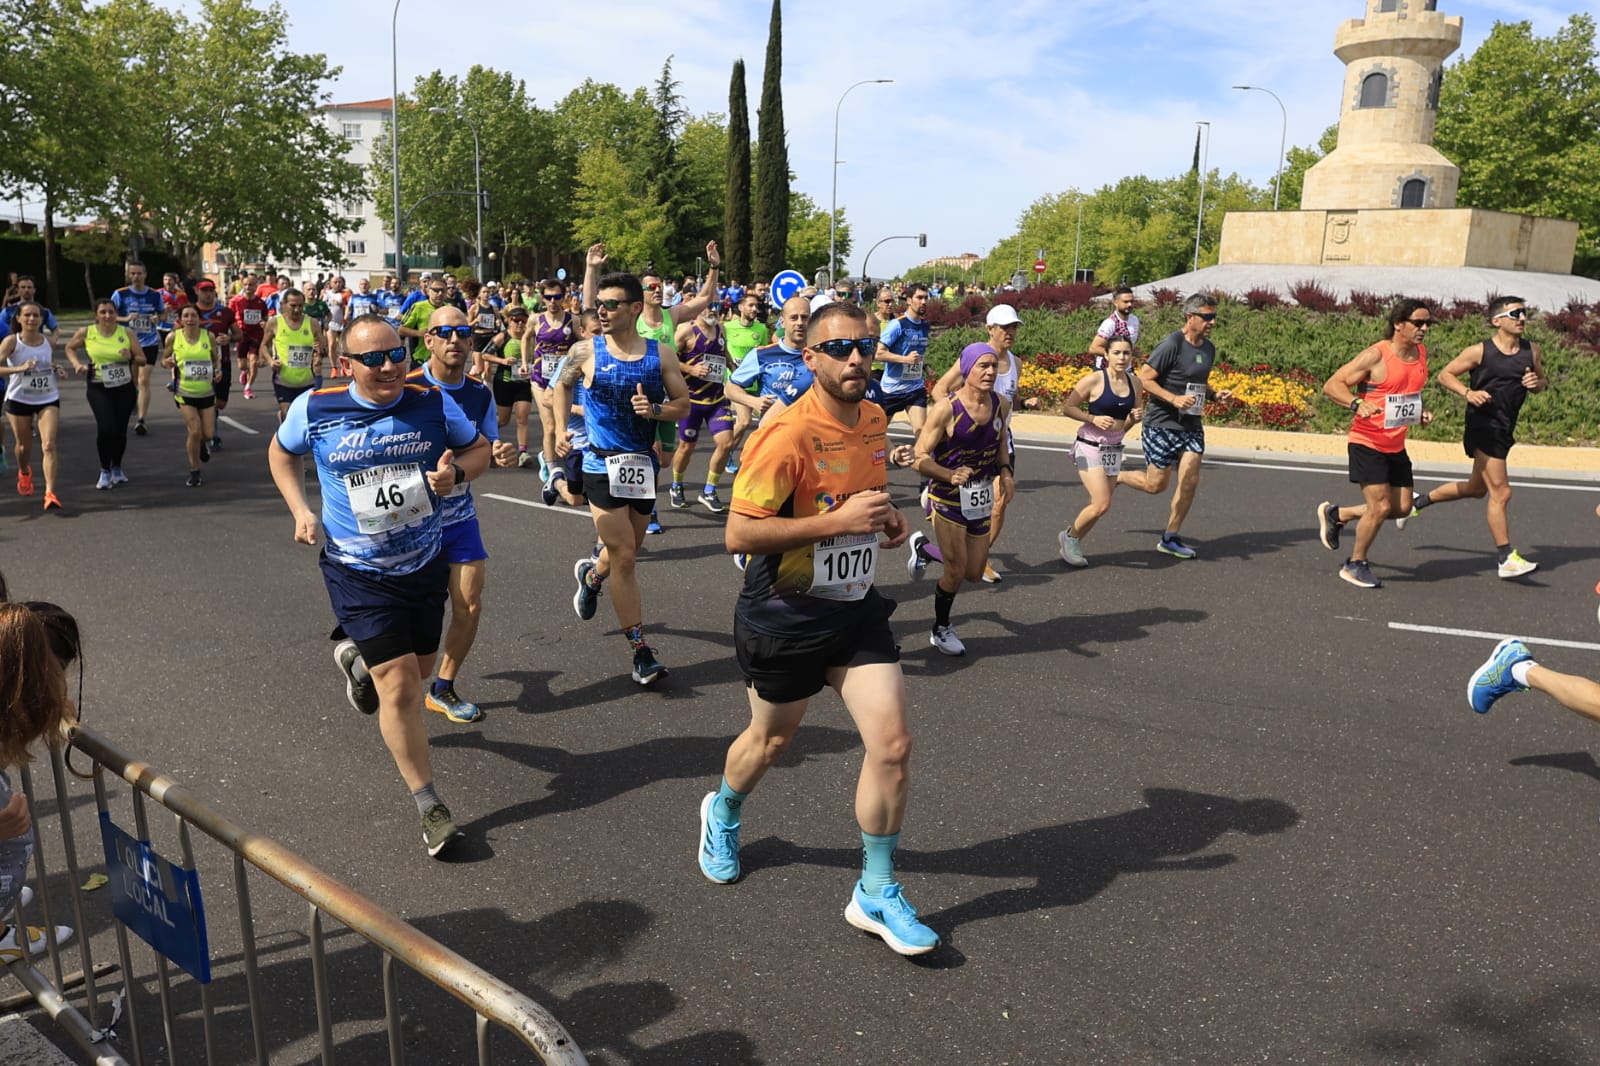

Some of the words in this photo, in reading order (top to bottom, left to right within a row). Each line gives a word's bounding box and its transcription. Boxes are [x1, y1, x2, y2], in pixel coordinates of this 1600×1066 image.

[293, 351, 309, 362] 587
[108, 367, 126, 380] 588
[190, 366, 208, 377] 589
[30, 376, 49, 389] 492
[1394, 403, 1415, 418] 762
[336, 432, 367, 450] XII
[371, 431, 421, 446] CARRERA
[1101, 453, 1117, 466] 633
[349, 474, 365, 488] XII
[619, 467, 645, 485] 825
[375, 484, 405, 511] 46
[970, 488, 991, 507] 552
[823, 547, 873, 582] 1070
[122, 872, 176, 929] LOCAL
